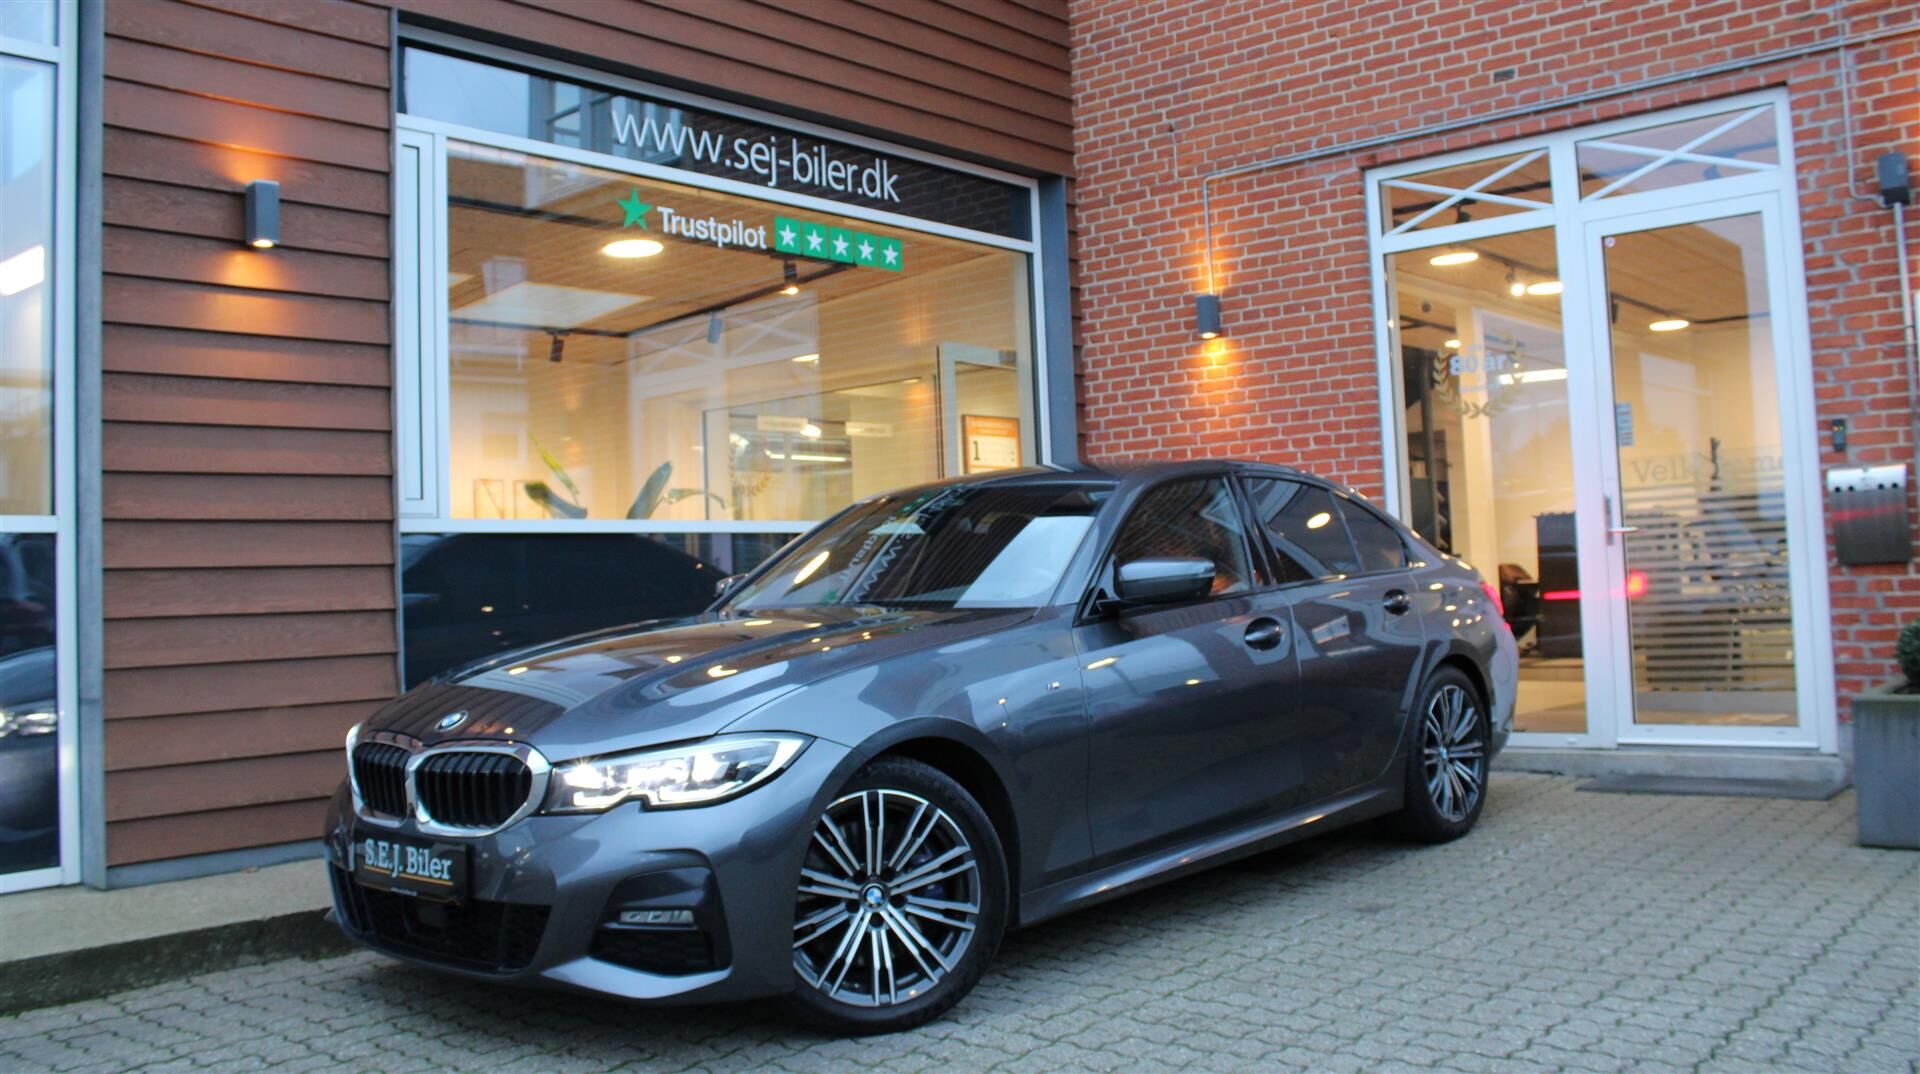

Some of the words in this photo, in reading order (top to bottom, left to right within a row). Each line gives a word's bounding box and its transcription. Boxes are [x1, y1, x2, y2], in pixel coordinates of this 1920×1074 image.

[611, 110, 900, 203] www.sej-biler.dk
[656, 206, 767, 250] Trustpilot
[364, 838, 404, 879] S.E.J.
[406, 846, 453, 880] Biler
